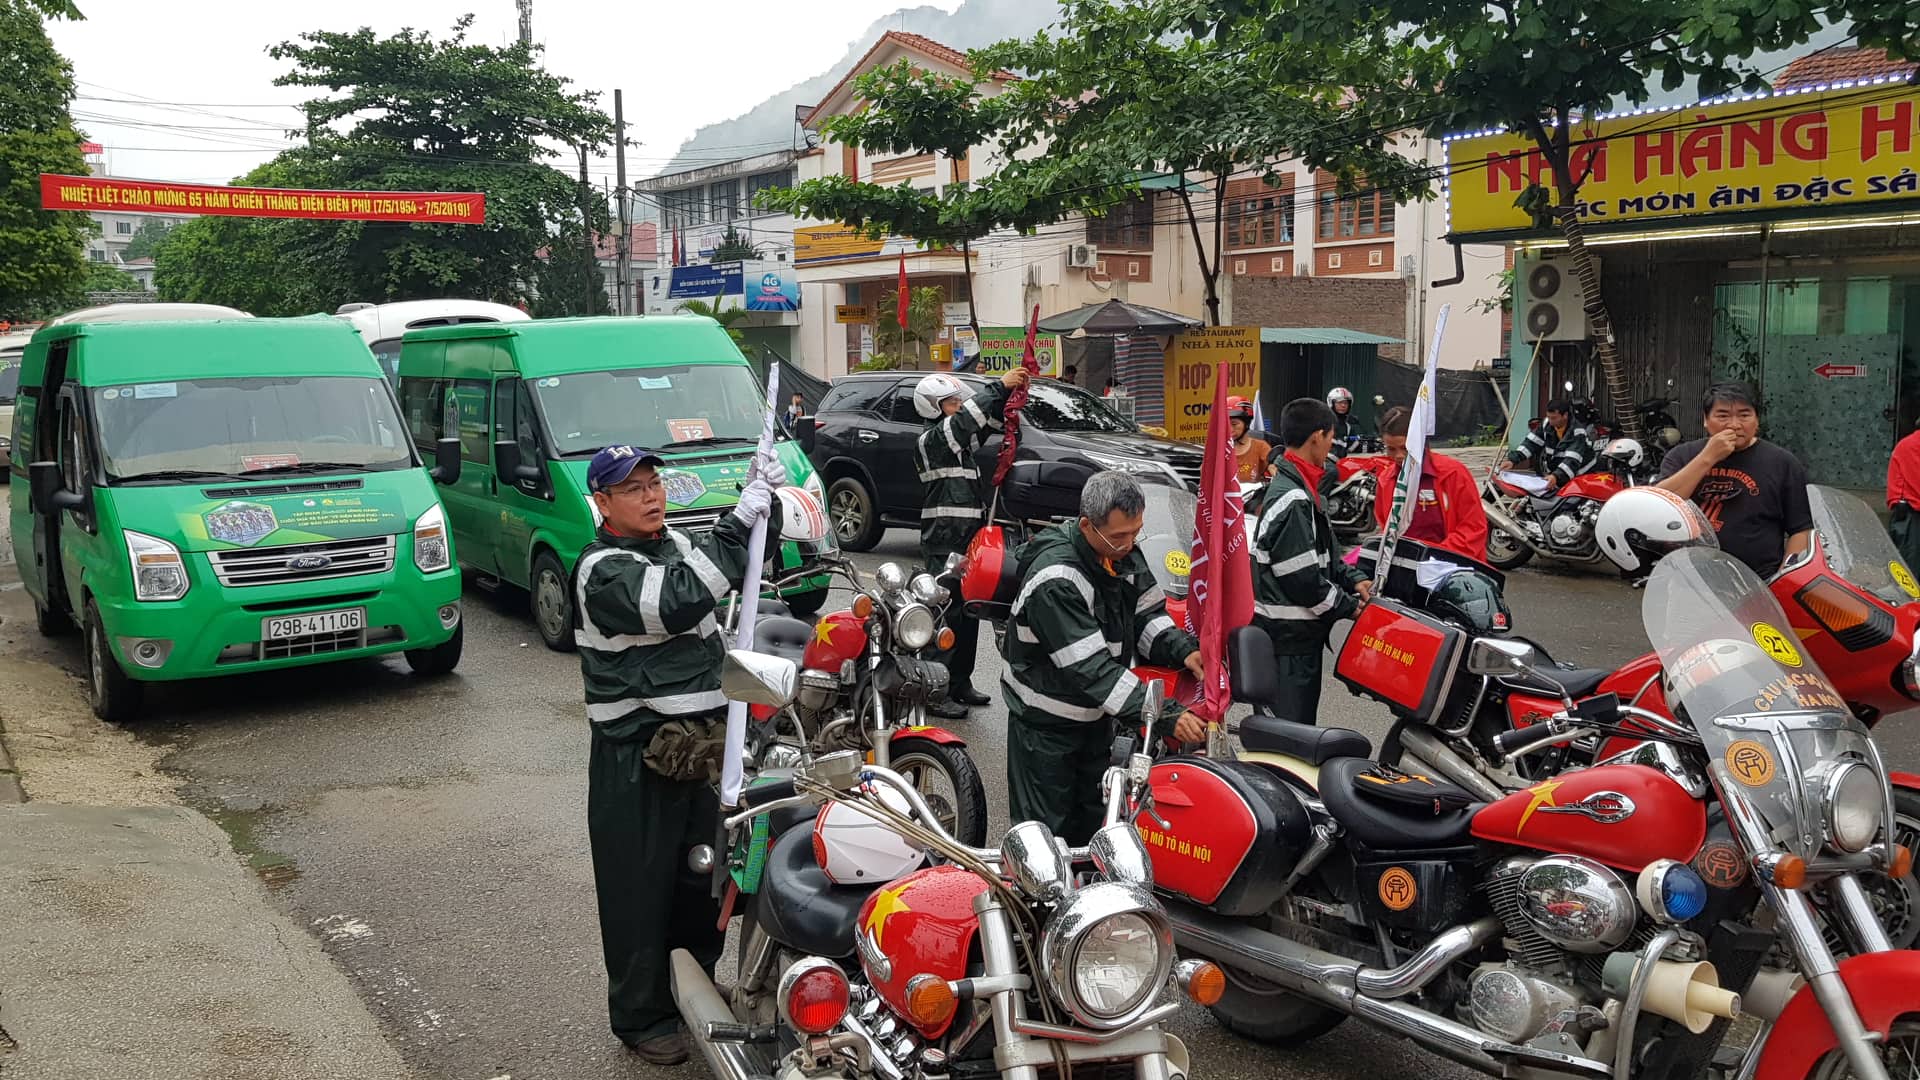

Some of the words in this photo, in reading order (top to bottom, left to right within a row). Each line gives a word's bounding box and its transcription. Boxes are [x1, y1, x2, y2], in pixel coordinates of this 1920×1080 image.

[1486, 129, 1608, 194] NHÀ
[1633, 114, 1829, 184] HÀNG
[1860, 101, 1920, 164] H
[60, 184, 93, 207] NHIỆT
[96, 185, 119, 208] LIỆT
[121, 186, 151, 205] CHÀO
[153, 186, 187, 207] MỪNG
[189, 192, 203, 207] 65
[204, 190, 230, 209] NĂM
[232, 190, 264, 209] CHIẾN
[265, 191, 298, 211] THẮNG
[301, 194, 324, 215] ĐIỆN
[326, 194, 350, 212] BIÊN
[351, 193, 371, 214] PHỦ
[373, 199, 417, 215] (7/5/1954
[1573, 199, 1607, 218] ÁC
[1618, 191, 1695, 215] MÓN
[1708, 185, 1760, 209] ĂN
[1773, 176, 1853, 202] ĐẶC
[763, 276, 778, 286] 4G
[1190, 328, 1246, 337] RESTAURANT
[1002, 337, 1015, 350] GÀ
[1182, 338, 1211, 349] NHÀ
[1215, 338, 1254, 349] HÀNG
[984, 351, 1012, 371] BÚN
[1179, 361, 1212, 396] HỢP
[1216, 352, 1257, 388] HỦY
[681, 429, 705, 439] 12
[297, 557, 322, 568] Ford
[1170, 556, 1187, 569] 32
[272, 612, 360, 638] 29B-411.06
[1361, 633, 1375, 648] CLB
[1763, 635, 1791, 655] 27
[1150, 831, 1165, 848] MÔ
[1166, 834, 1177, 852] TÔ
[1178, 839, 1191, 857] HÀ
[1193, 844, 1212, 865] NỘI
